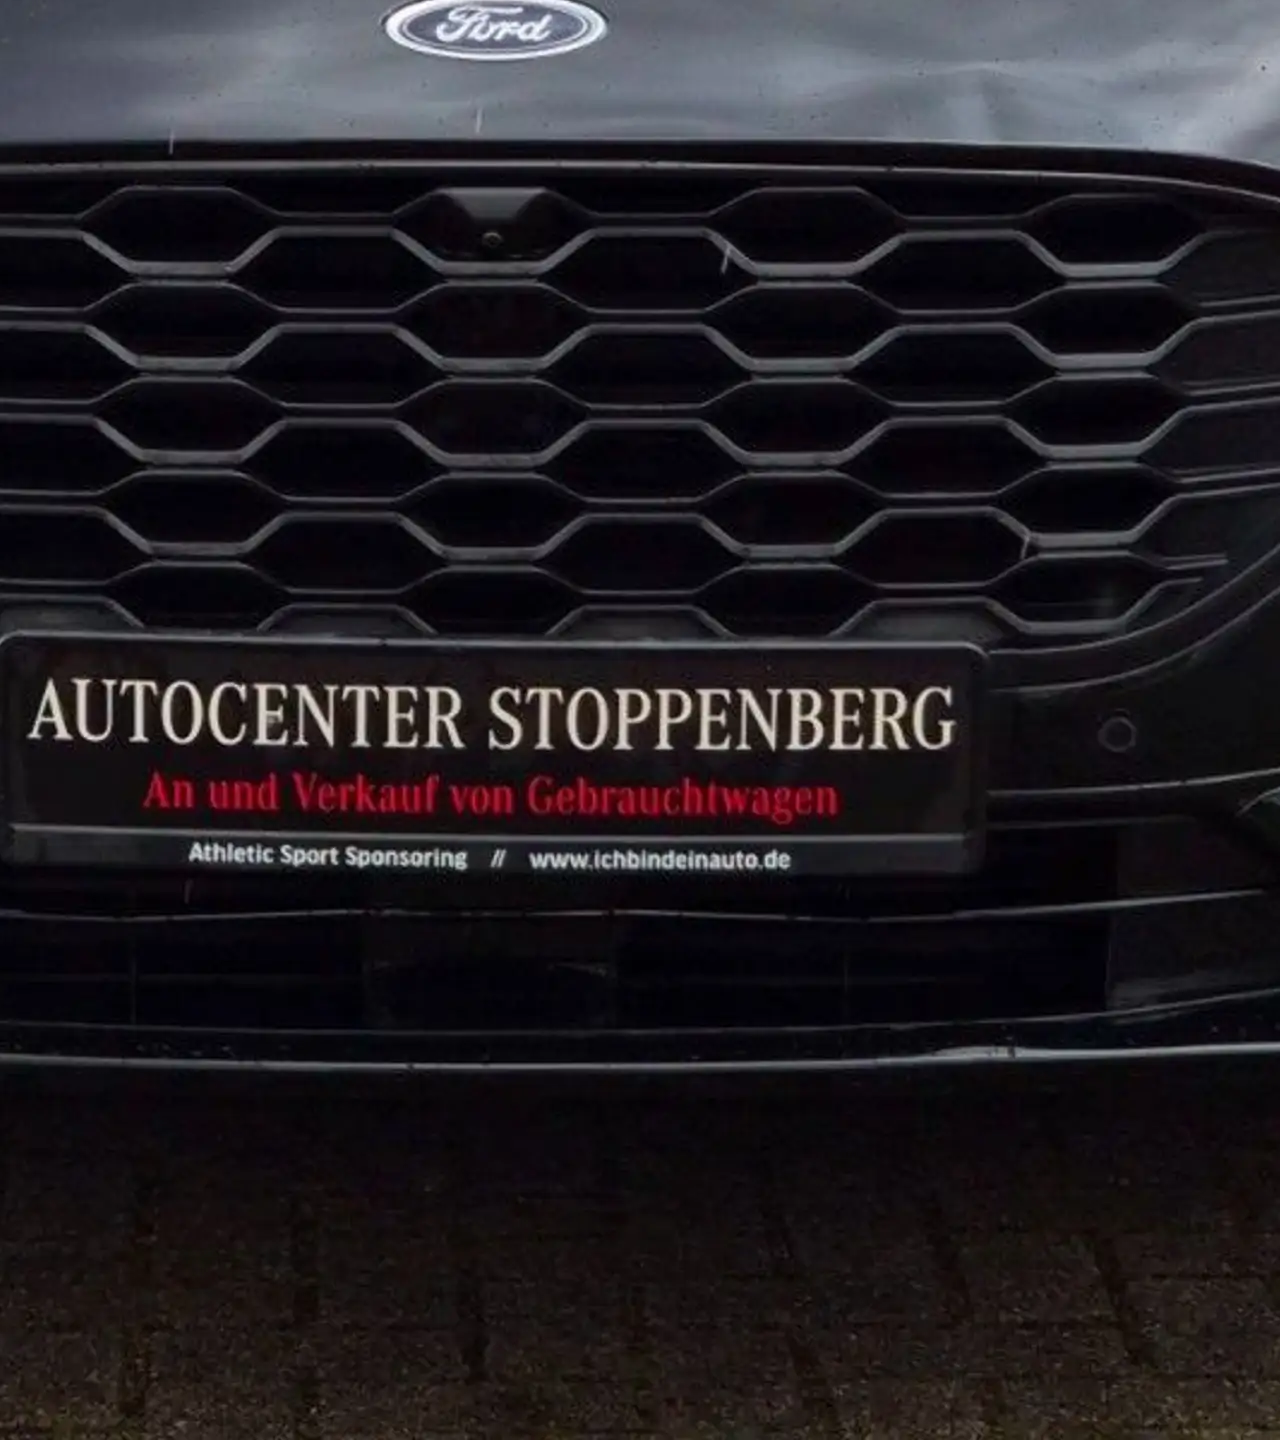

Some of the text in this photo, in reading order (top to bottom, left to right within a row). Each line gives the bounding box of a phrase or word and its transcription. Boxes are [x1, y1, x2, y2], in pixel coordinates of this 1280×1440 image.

[437, 5, 553, 42] Ford
[28, 678, 956, 751] AUTOCENTER STOPPENBERG
[143, 771, 839, 825] An und Verkauf von Gebrauchtwagen
[189, 841, 274, 864] Athletic
[280, 843, 340, 867] Sport
[345, 844, 467, 869] Sponsoring
[529, 849, 791, 870] www.ichbindeinauto.de
